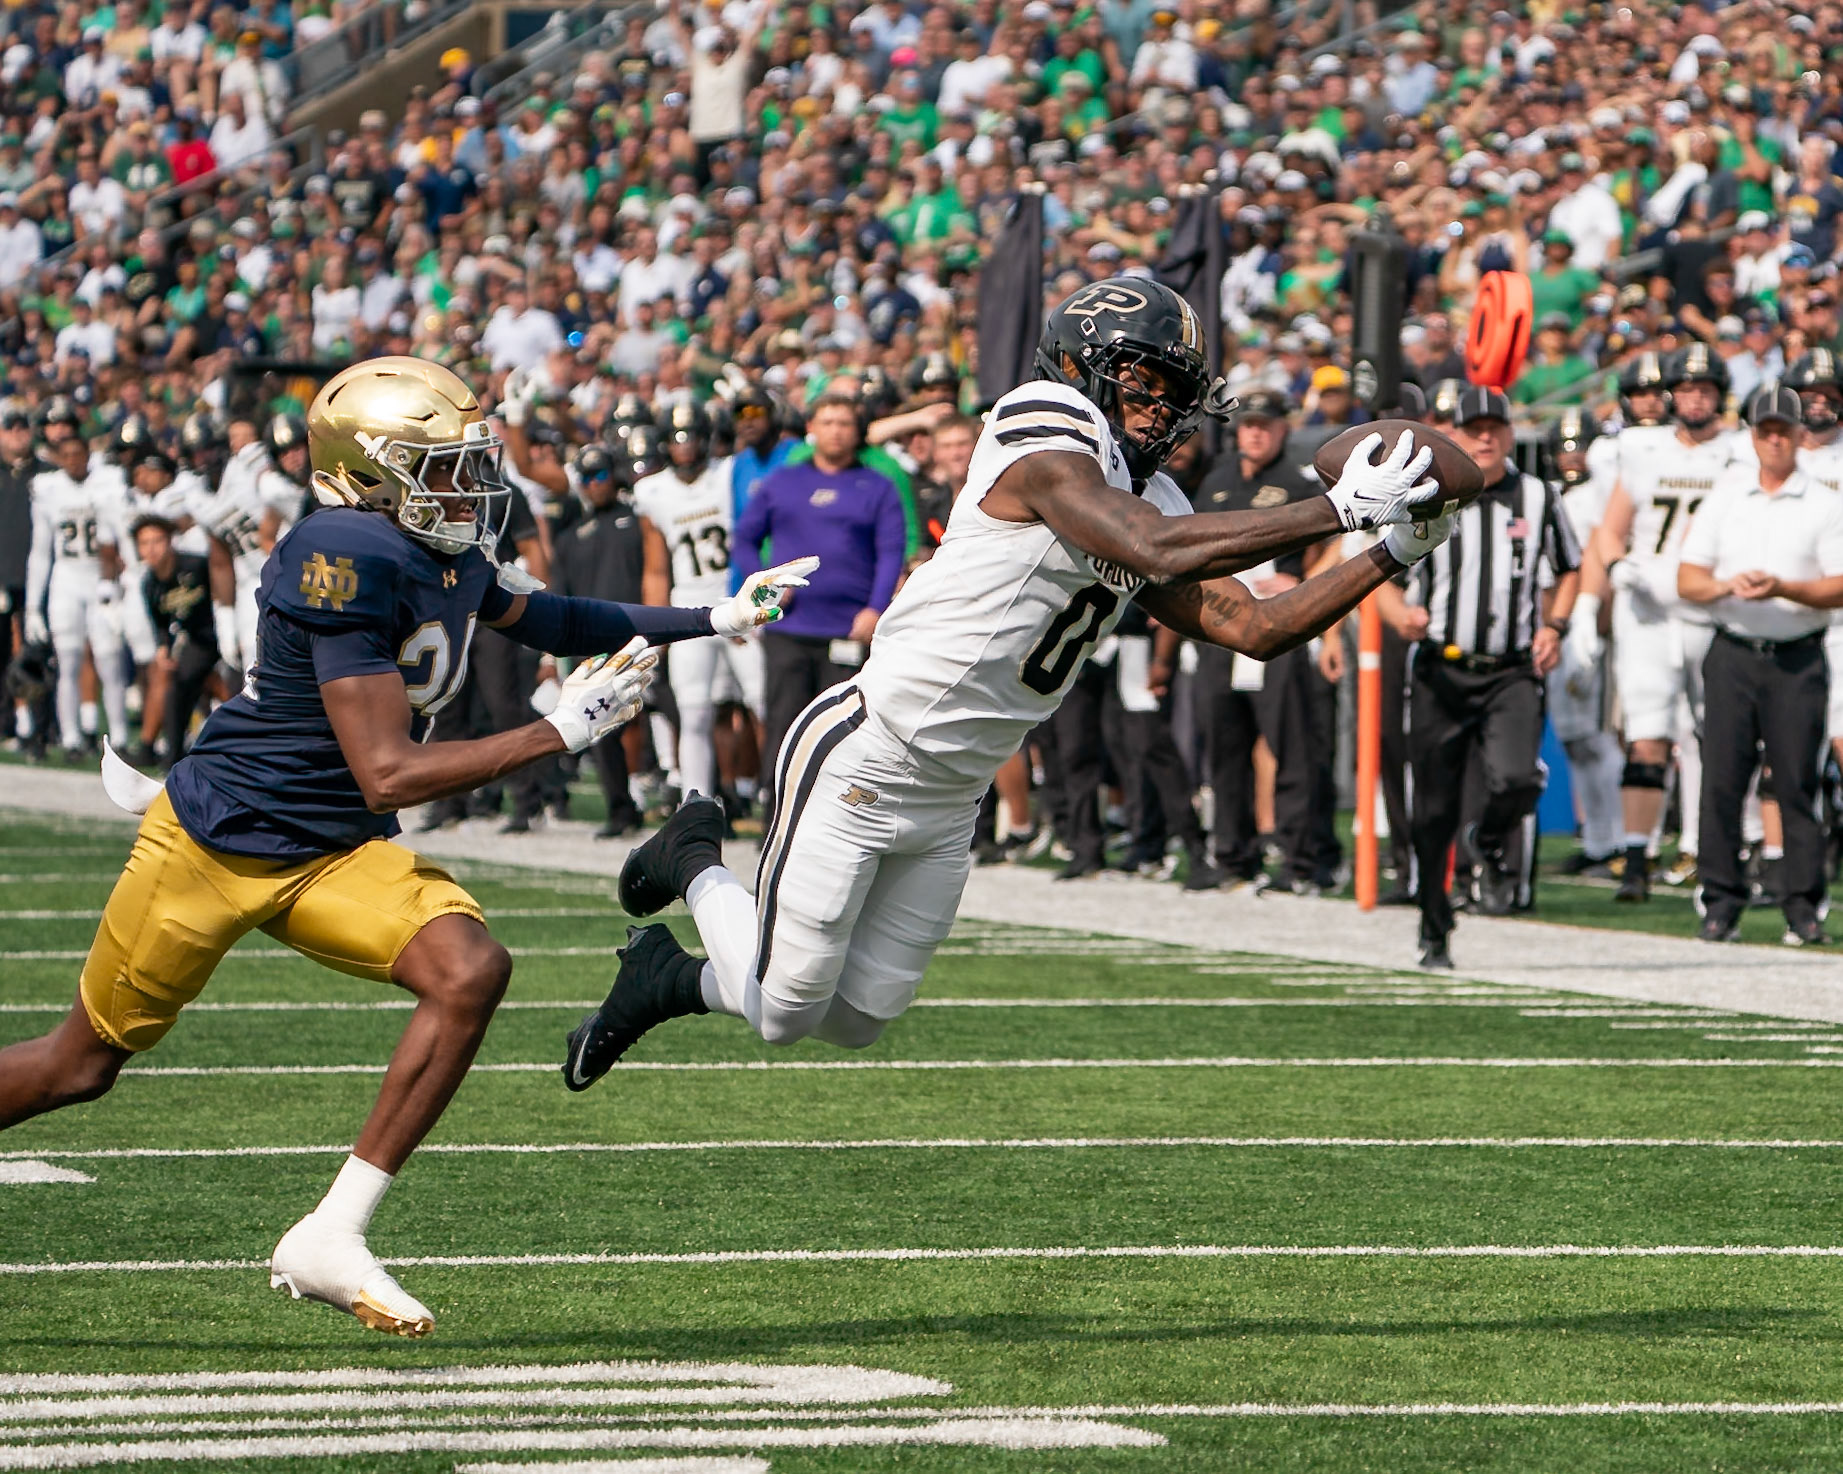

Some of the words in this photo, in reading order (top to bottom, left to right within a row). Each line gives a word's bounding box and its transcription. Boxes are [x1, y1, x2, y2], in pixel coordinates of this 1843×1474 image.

[1063, 284, 1148, 317] P
[678, 522, 731, 577] 13
[1653, 494, 1704, 555] 7
[1019, 580, 1119, 696] 0
[838, 783, 879, 807] P
